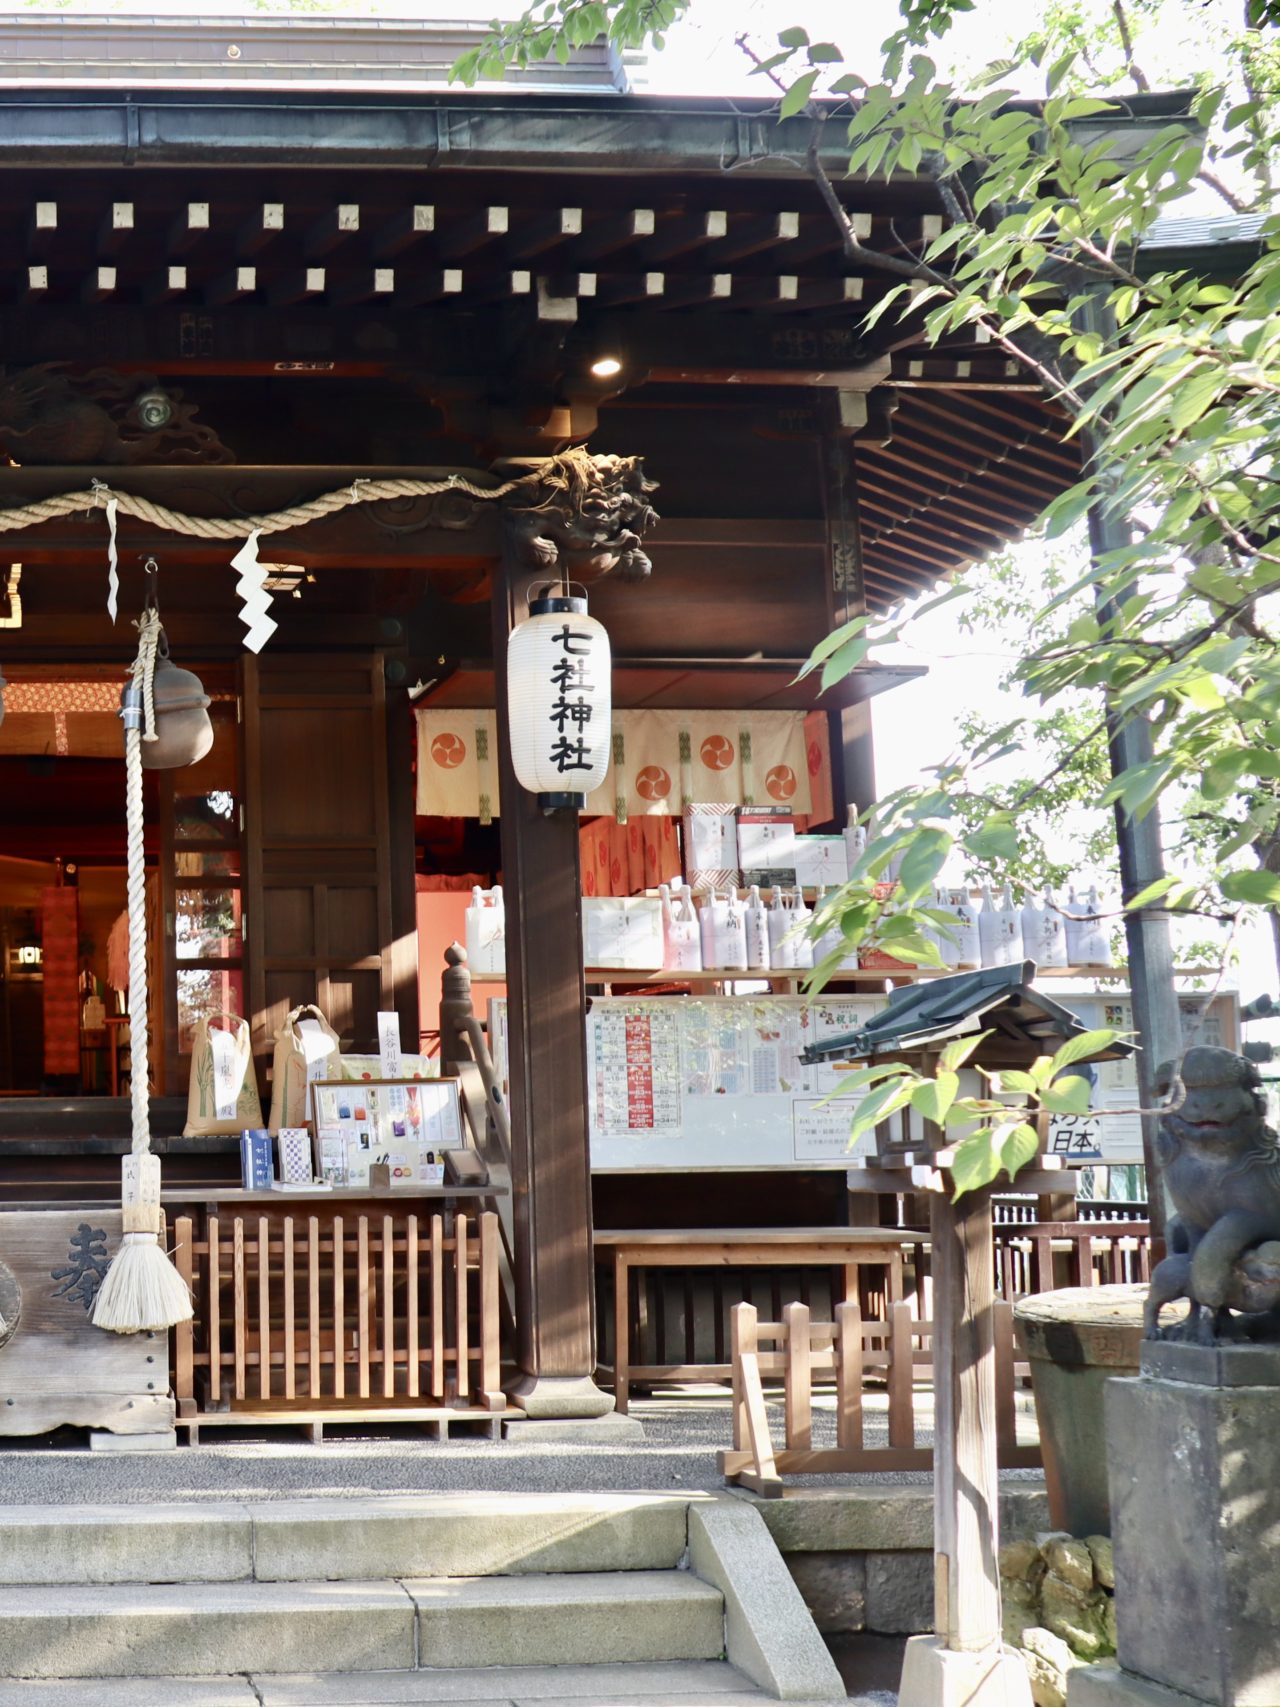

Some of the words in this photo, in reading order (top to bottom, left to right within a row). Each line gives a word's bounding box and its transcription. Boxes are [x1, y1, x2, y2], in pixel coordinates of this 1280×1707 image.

[549, 624, 596, 774] 七社神社
[1053, 1129, 1101, 1152] 日本。
[50, 1222, 113, 1311] 奉
